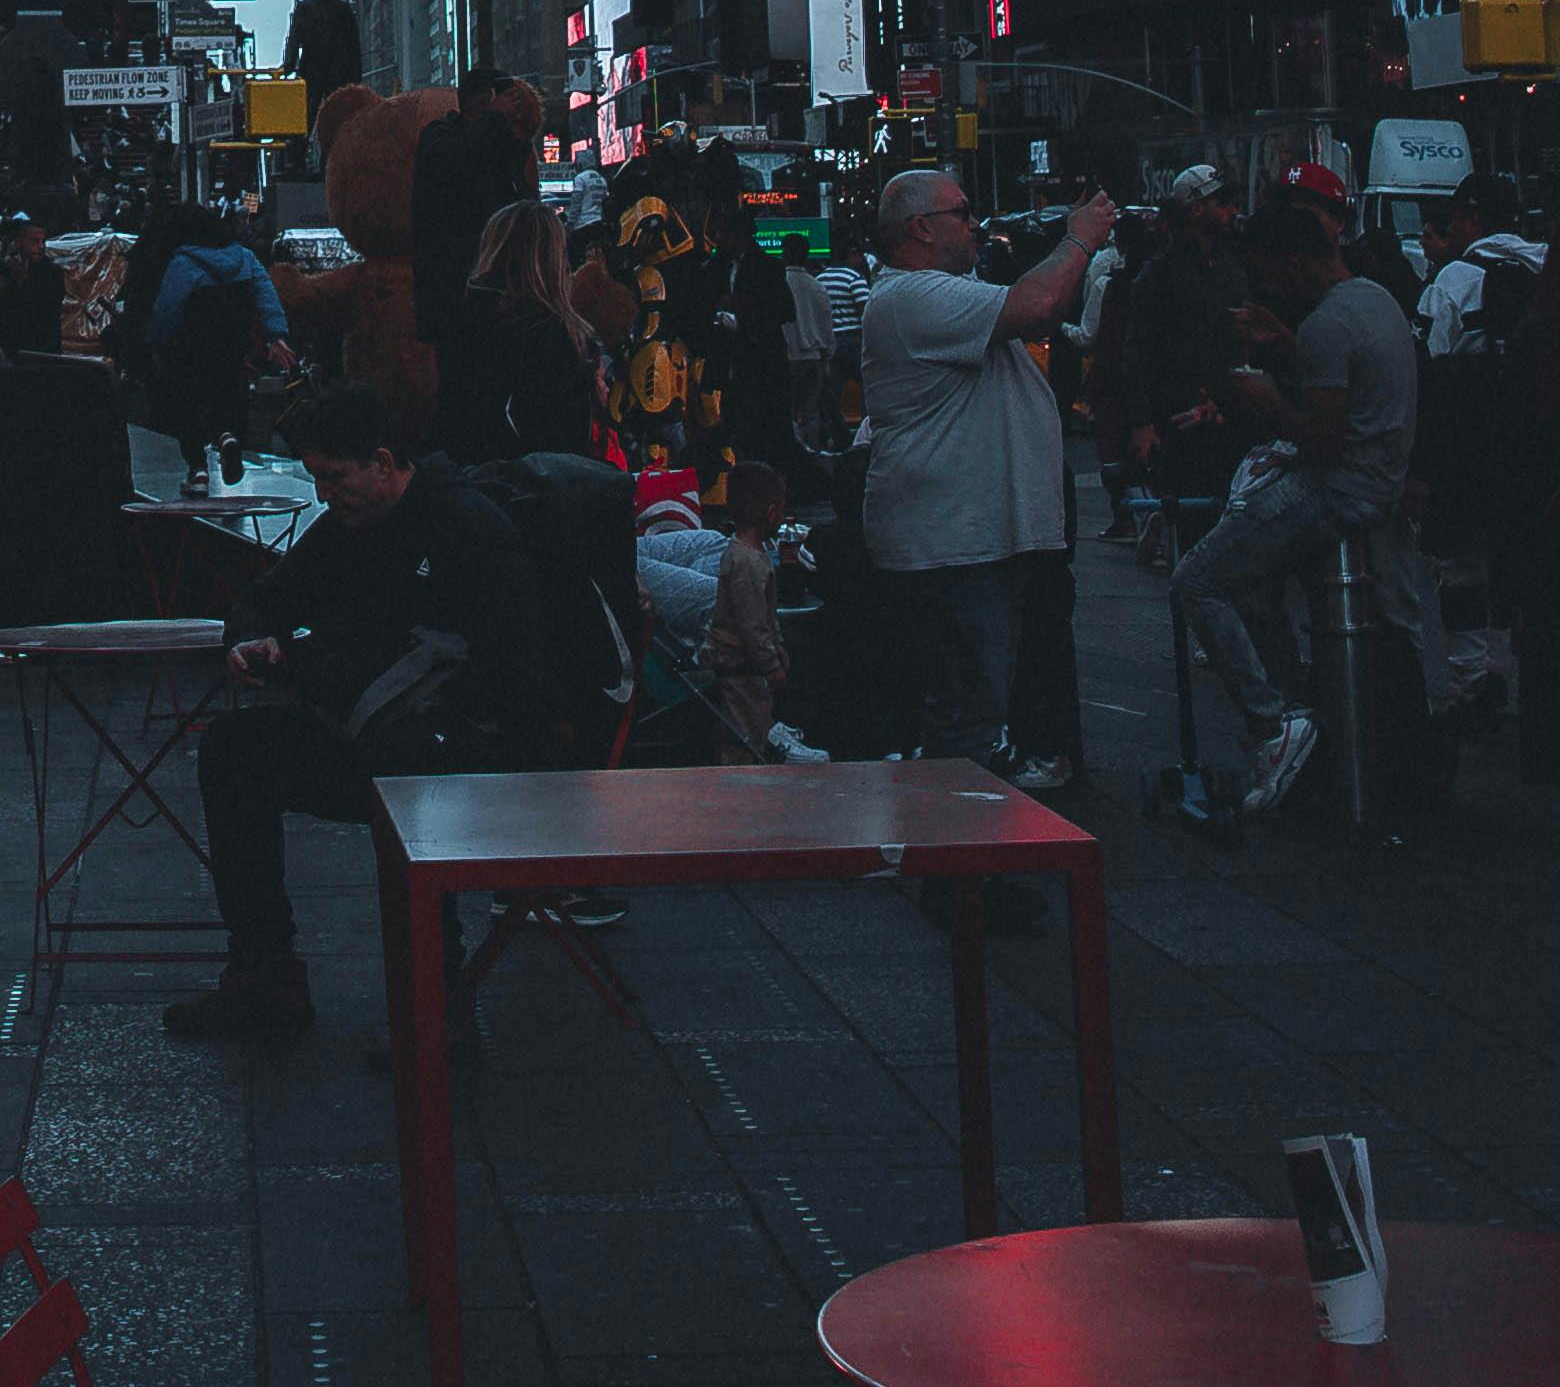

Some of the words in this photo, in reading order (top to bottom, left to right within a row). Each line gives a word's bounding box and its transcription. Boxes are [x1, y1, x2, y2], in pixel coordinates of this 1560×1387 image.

[69, 72, 120, 86] PEDESTRIAN
[121, 71, 145, 85] FLOW
[147, 70, 169, 83] ZONE
[69, 88, 91, 101] KEEP
[92, 87, 124, 100] MOVING
[1399, 140, 1464, 161] Sysco
